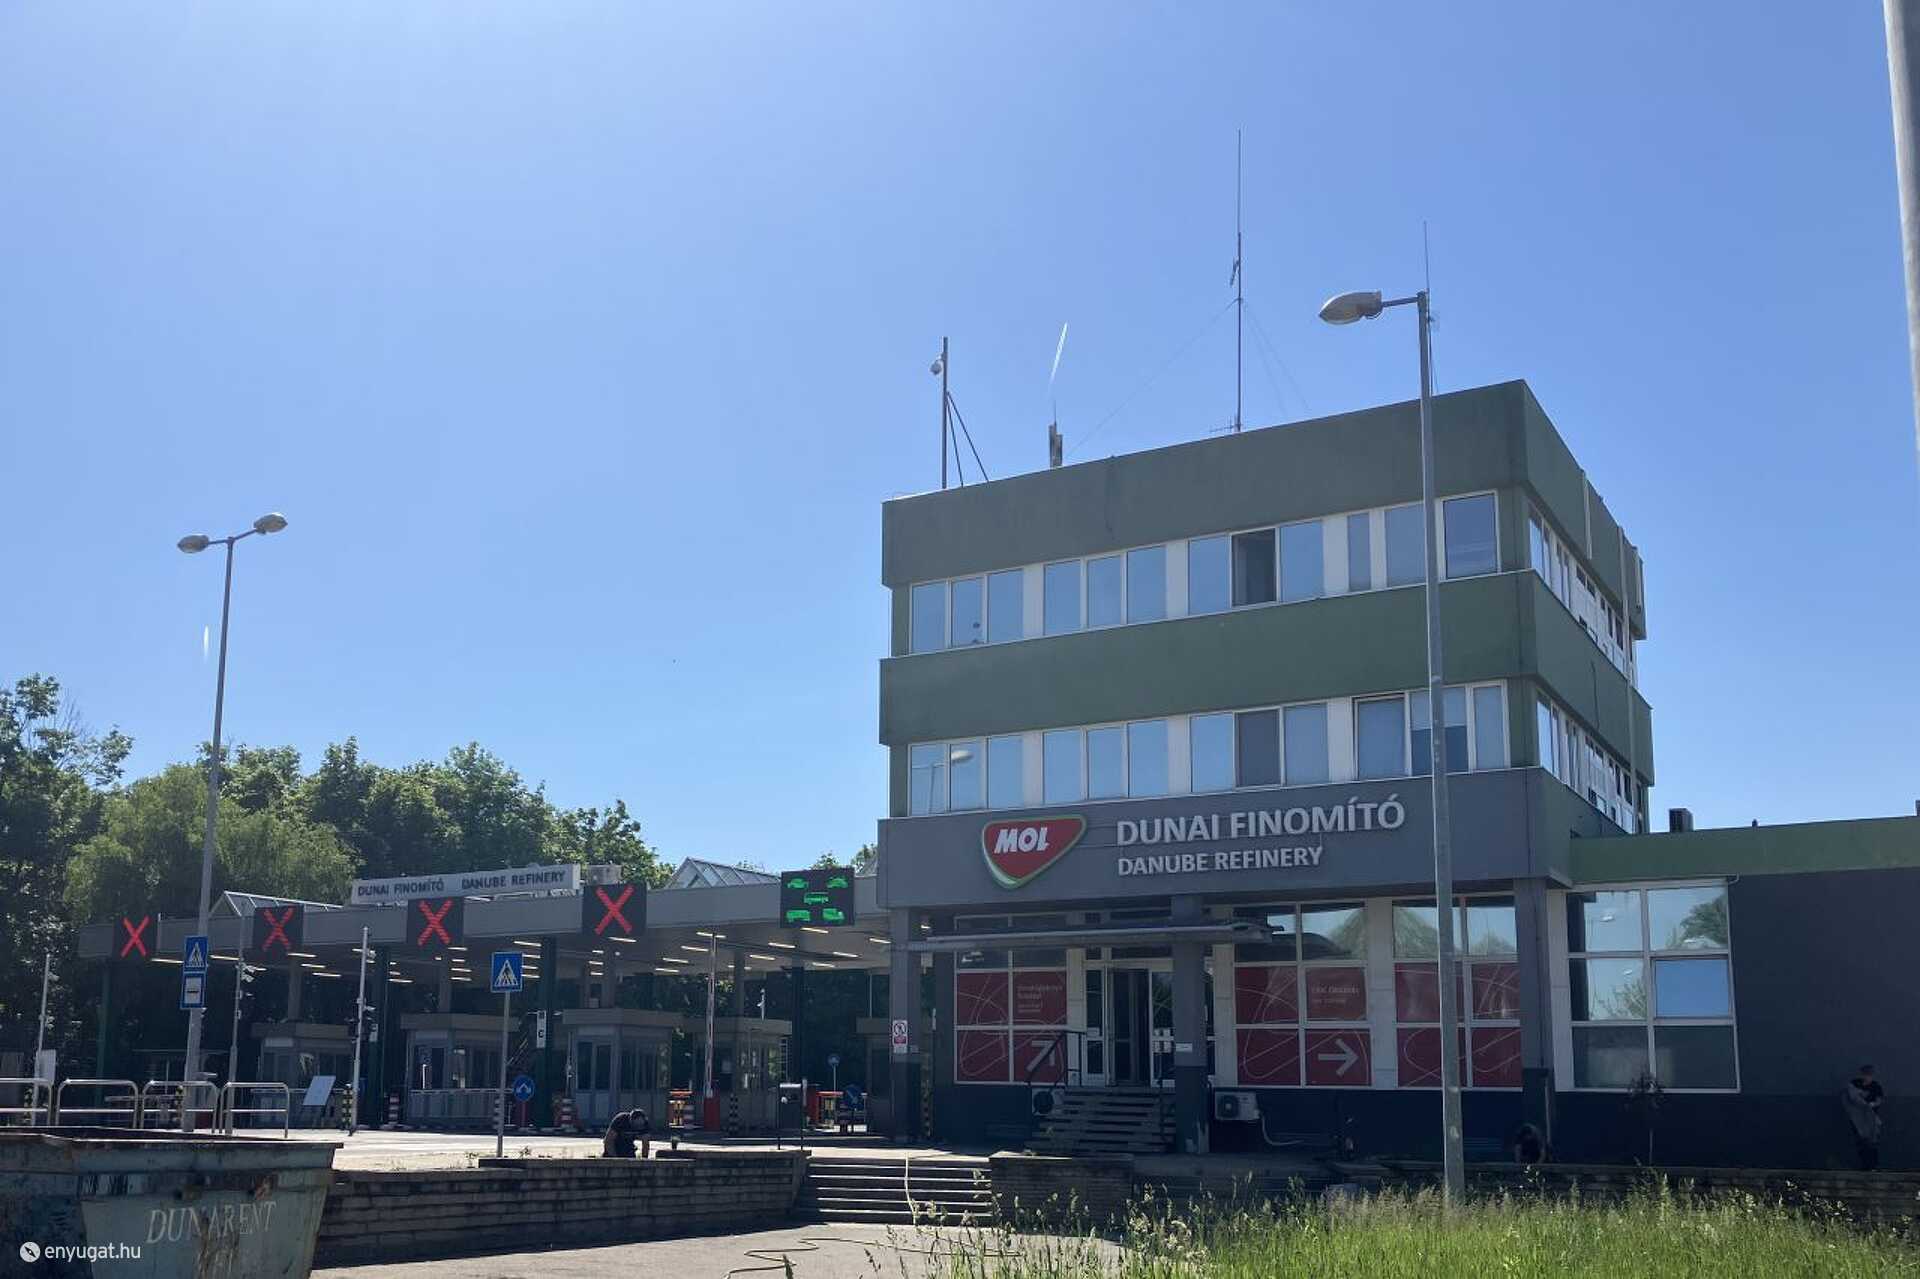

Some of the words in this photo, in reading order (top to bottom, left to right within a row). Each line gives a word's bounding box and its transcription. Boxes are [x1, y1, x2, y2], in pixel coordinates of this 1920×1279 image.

[1116, 814, 1220, 846] DUNAI
[1230, 795, 1406, 838] FINOMÍTÓ
[994, 827, 1049, 854] MOL
[1117, 853, 1209, 877] DANUBE
[1214, 845, 1323, 872] REFINERY
[357, 884, 389, 897] DUNAI
[393, 877, 444, 894] FINOMÍTÓ
[460, 874, 507, 890] DANUBE
[511, 870, 566, 886] REFINERY
